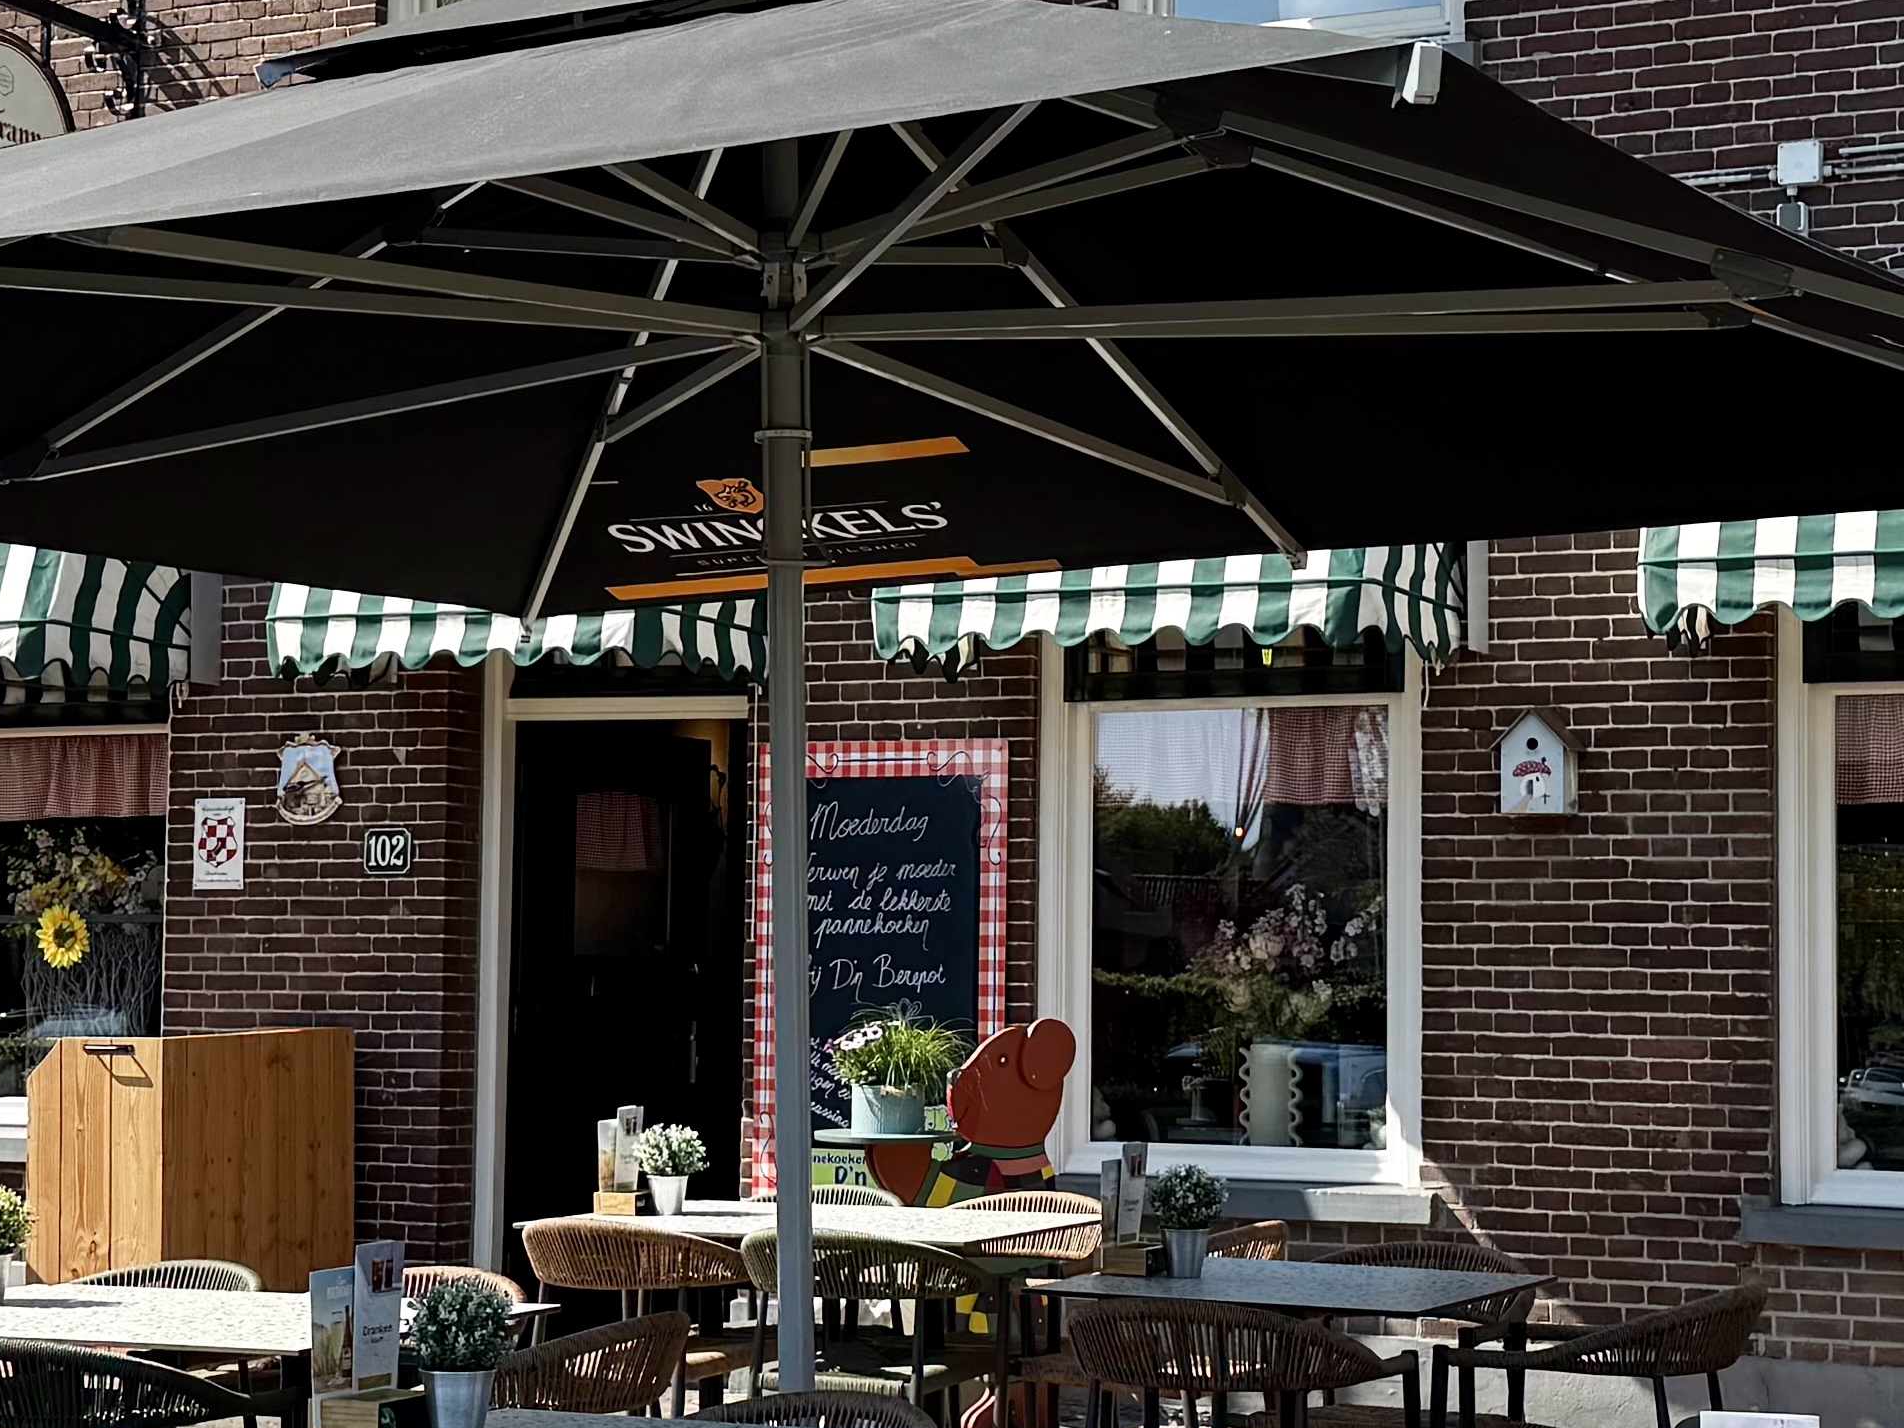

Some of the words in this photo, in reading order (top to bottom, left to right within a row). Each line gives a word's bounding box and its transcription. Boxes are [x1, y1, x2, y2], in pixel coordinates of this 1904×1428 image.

[809, 801, 929, 842] Moederdag
[368, 835, 405, 866] 102
[866, 862, 888, 891] je
[895, 858, 957, 881] moeder
[848, 889, 872, 913] de
[879, 886, 952, 913] lekkerste
[813, 912, 930, 951] pannekoeken
[872, 953, 947, 993] Berepot
